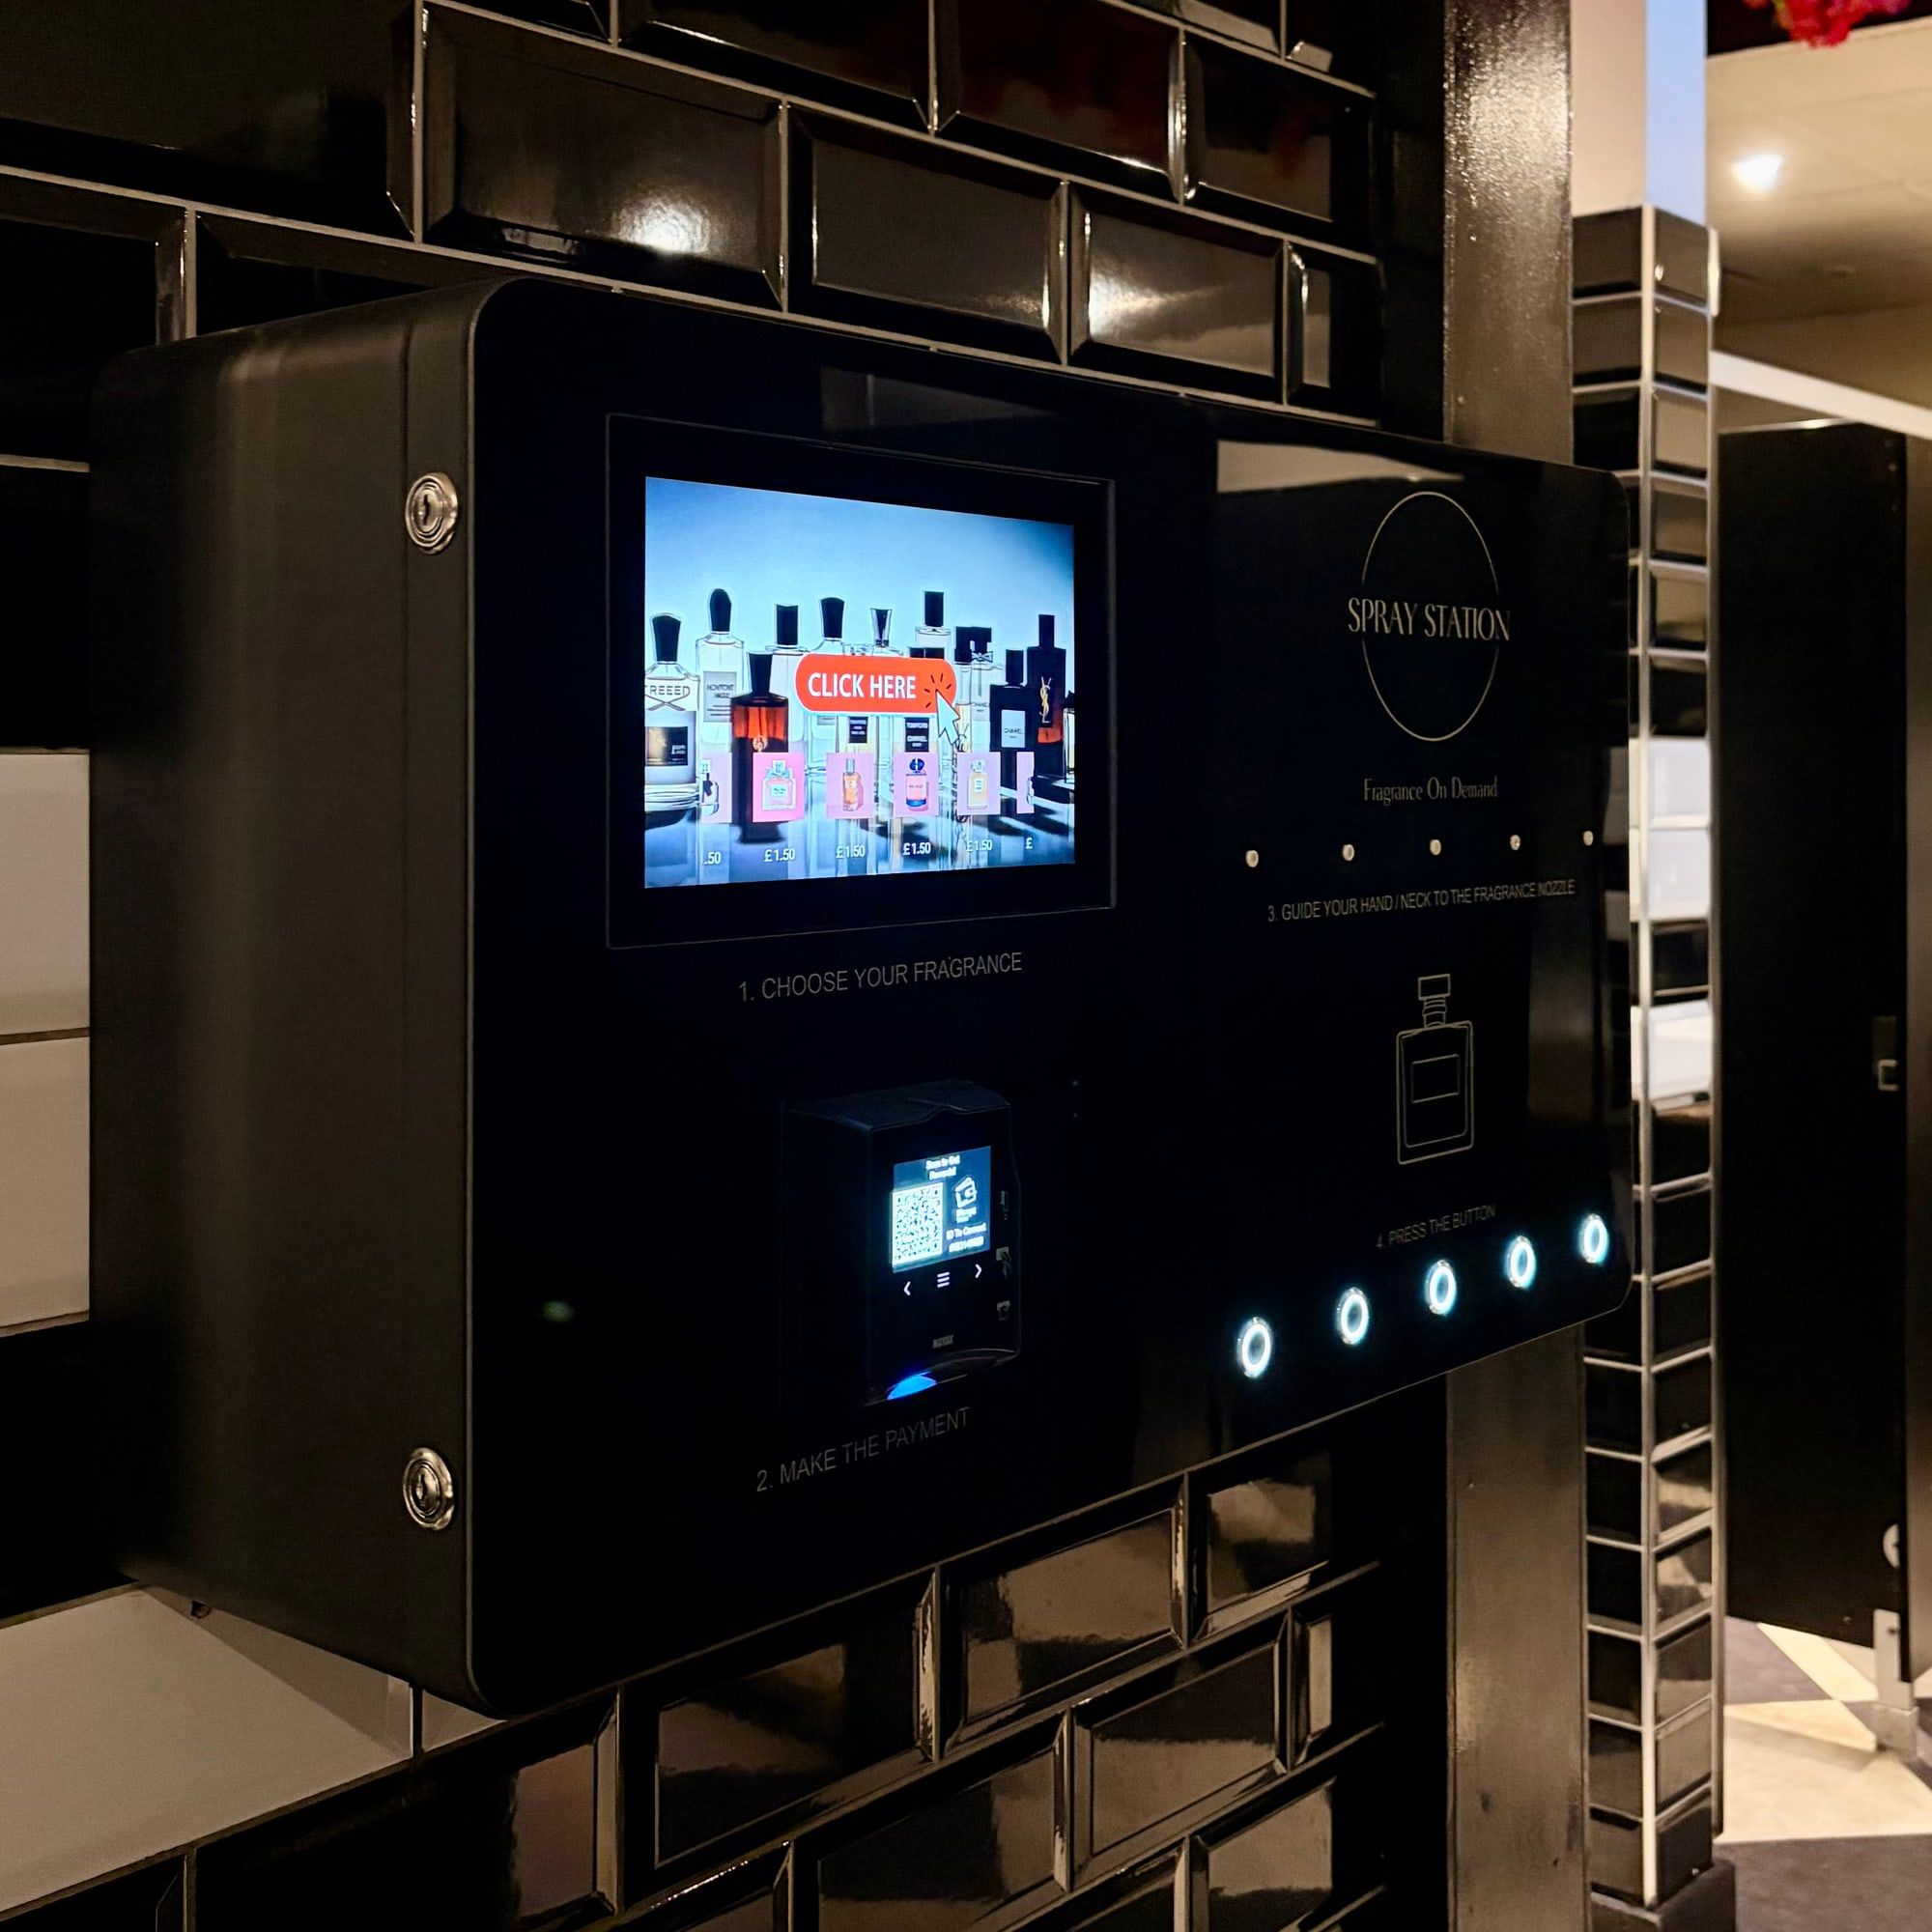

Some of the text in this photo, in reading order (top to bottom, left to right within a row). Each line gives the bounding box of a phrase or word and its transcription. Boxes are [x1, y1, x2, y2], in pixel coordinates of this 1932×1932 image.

[1347, 596, 1511, 641] SPRAY STATION
[808, 672, 917, 699] CLICK HERE
[1363, 774, 1498, 807] Fragrance On Demand
[763, 848, 796, 863] £1.50
[836, 844, 866, 859] £1.50
[902, 841, 932, 856] £1.50
[966, 838, 993, 852] £1.50
[1025, 837, 1034, 850] £
[1267, 904, 1278, 923] 3.
[1281, 899, 1321, 922] GUIDE
[1322, 897, 1359, 918] YOUR
[1361, 894, 1393, 914] HAND
[1400, 890, 1433, 910] NECK
[1434, 889, 1450, 907] TO
[1450, 887, 1473, 905] THE
[1473, 881, 1538, 903] FRAGRANCE
[1538, 878, 1577, 896] NOZZLE
[738, 952, 1023, 1003] 1. CHOOSE YOUR FRAGRANCE
[1388, 1222, 1428, 1248] PRESS
[1429, 1213, 1452, 1235] THE
[1452, 1202, 1498, 1230] BUTTON
[755, 1406, 972, 1492] 2. MAKE THE PAYMENT
